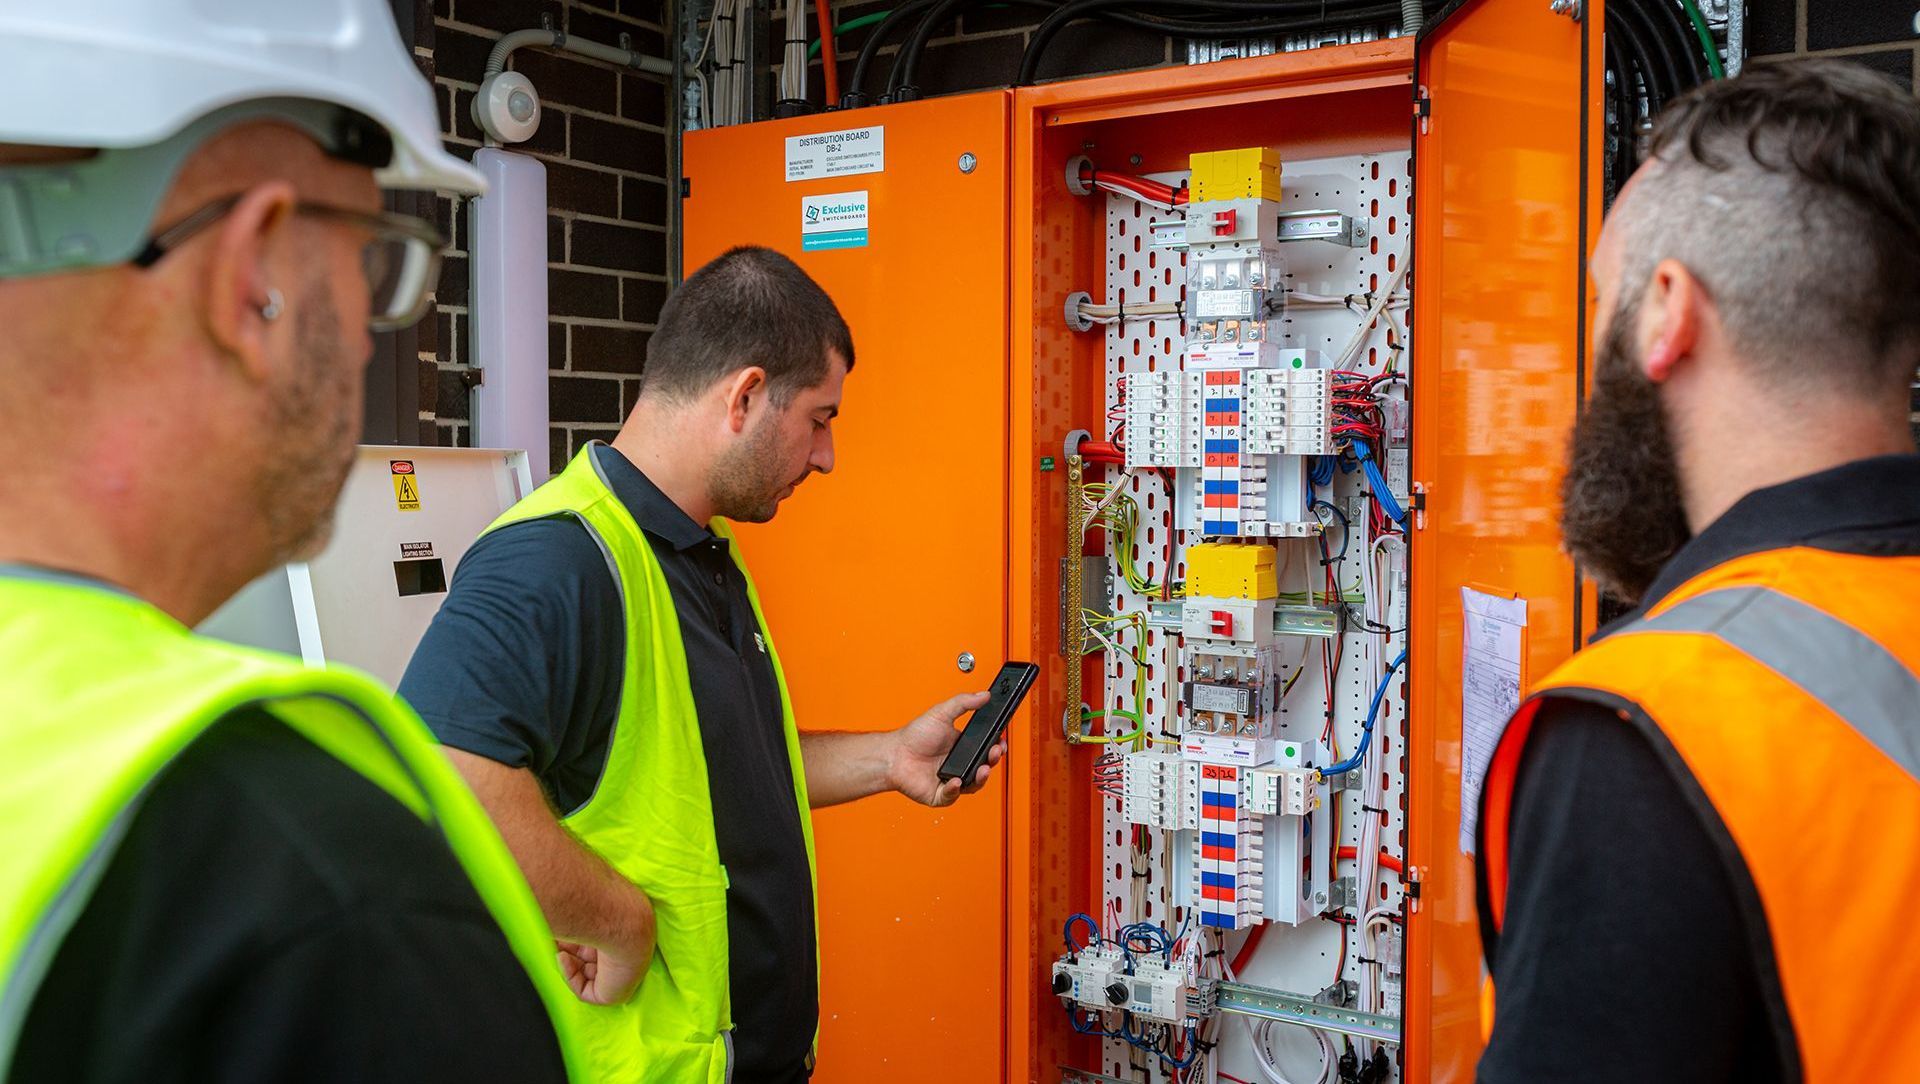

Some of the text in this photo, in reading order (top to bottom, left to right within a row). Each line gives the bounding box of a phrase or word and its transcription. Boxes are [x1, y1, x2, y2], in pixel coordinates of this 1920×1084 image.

[799, 130, 869, 147] DISTRIBUTION BOARD
[826, 144, 841, 153] DB-2
[822, 203, 865, 214] Exclusive
